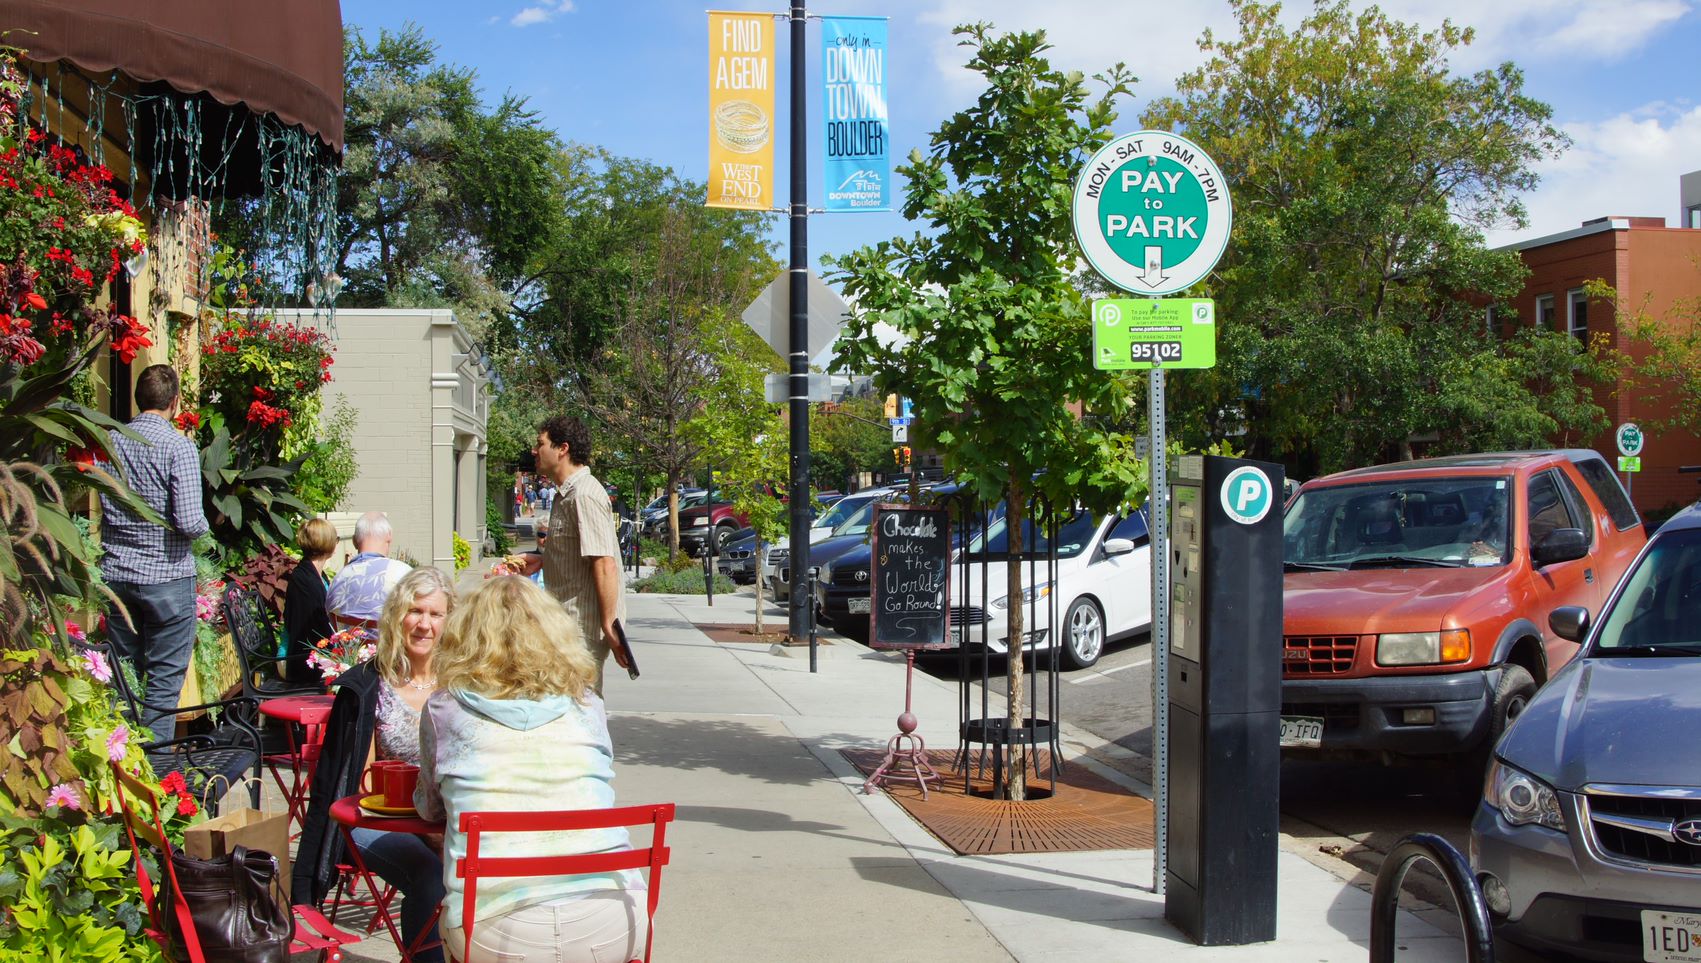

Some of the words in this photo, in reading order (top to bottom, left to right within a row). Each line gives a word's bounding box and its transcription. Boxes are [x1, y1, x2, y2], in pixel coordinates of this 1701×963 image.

[722, 19, 762, 53] FIND
[836, 33, 858, 52] only
[862, 32, 871, 47] in
[716, 56, 729, 89] A
[731, 57, 767, 90] GEM
[826, 46, 882, 84] DOWN
[826, 84, 885, 120] TOWN
[828, 121, 883, 157] BOULDER
[721, 163, 762, 182] WEST
[1086, 162, 1111, 199] MON
[1116, 140, 1144, 160] SAT
[1162, 141, 1195, 166] 9AM
[1198, 168, 1219, 203] 7PM
[1121, 170, 1184, 194] PAY
[720, 180, 762, 198] END
[829, 192, 881, 200] DOWNTOWN
[850, 199, 881, 207] Boulder
[1144, 198, 1163, 210] to
[1107, 214, 1199, 239] PARK
[1132, 343, 1180, 358] 95102
[1236, 479, 1262, 511] P
[883, 513, 938, 538] Chocolate
[888, 539, 924, 554] makes
[905, 555, 932, 570] the
[886, 571, 938, 594] World
[885, 596, 901, 612] Go
[905, 591, 942, 611] Round!
[1651, 926, 1689, 953] 1ED
